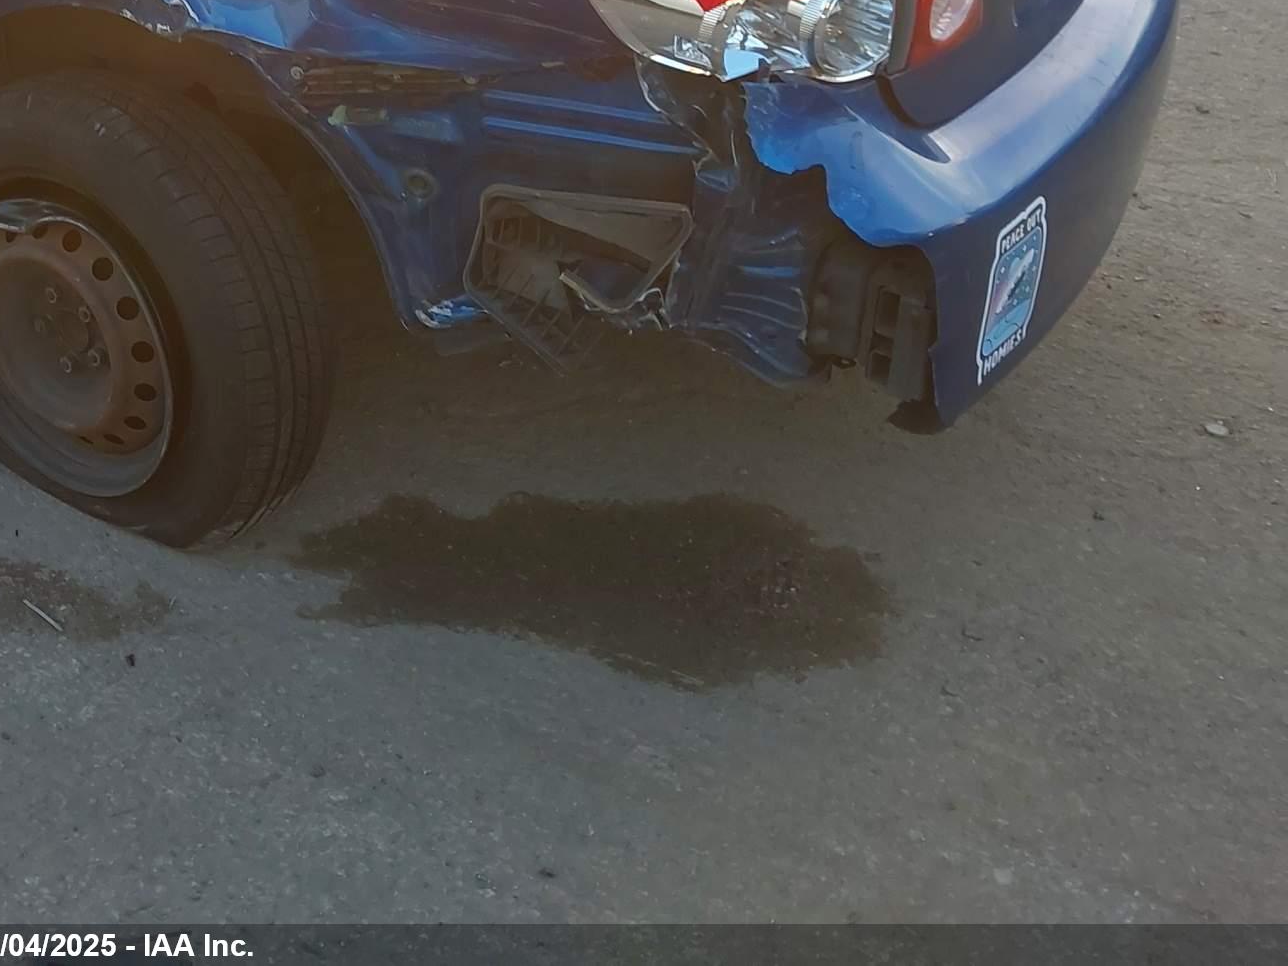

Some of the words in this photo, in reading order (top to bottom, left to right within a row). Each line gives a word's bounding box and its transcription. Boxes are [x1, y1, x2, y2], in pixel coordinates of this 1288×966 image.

[1001, 224, 1024, 254] PEACE
[1027, 208, 1041, 231] OUT
[983, 329, 1022, 376] HOMIES
